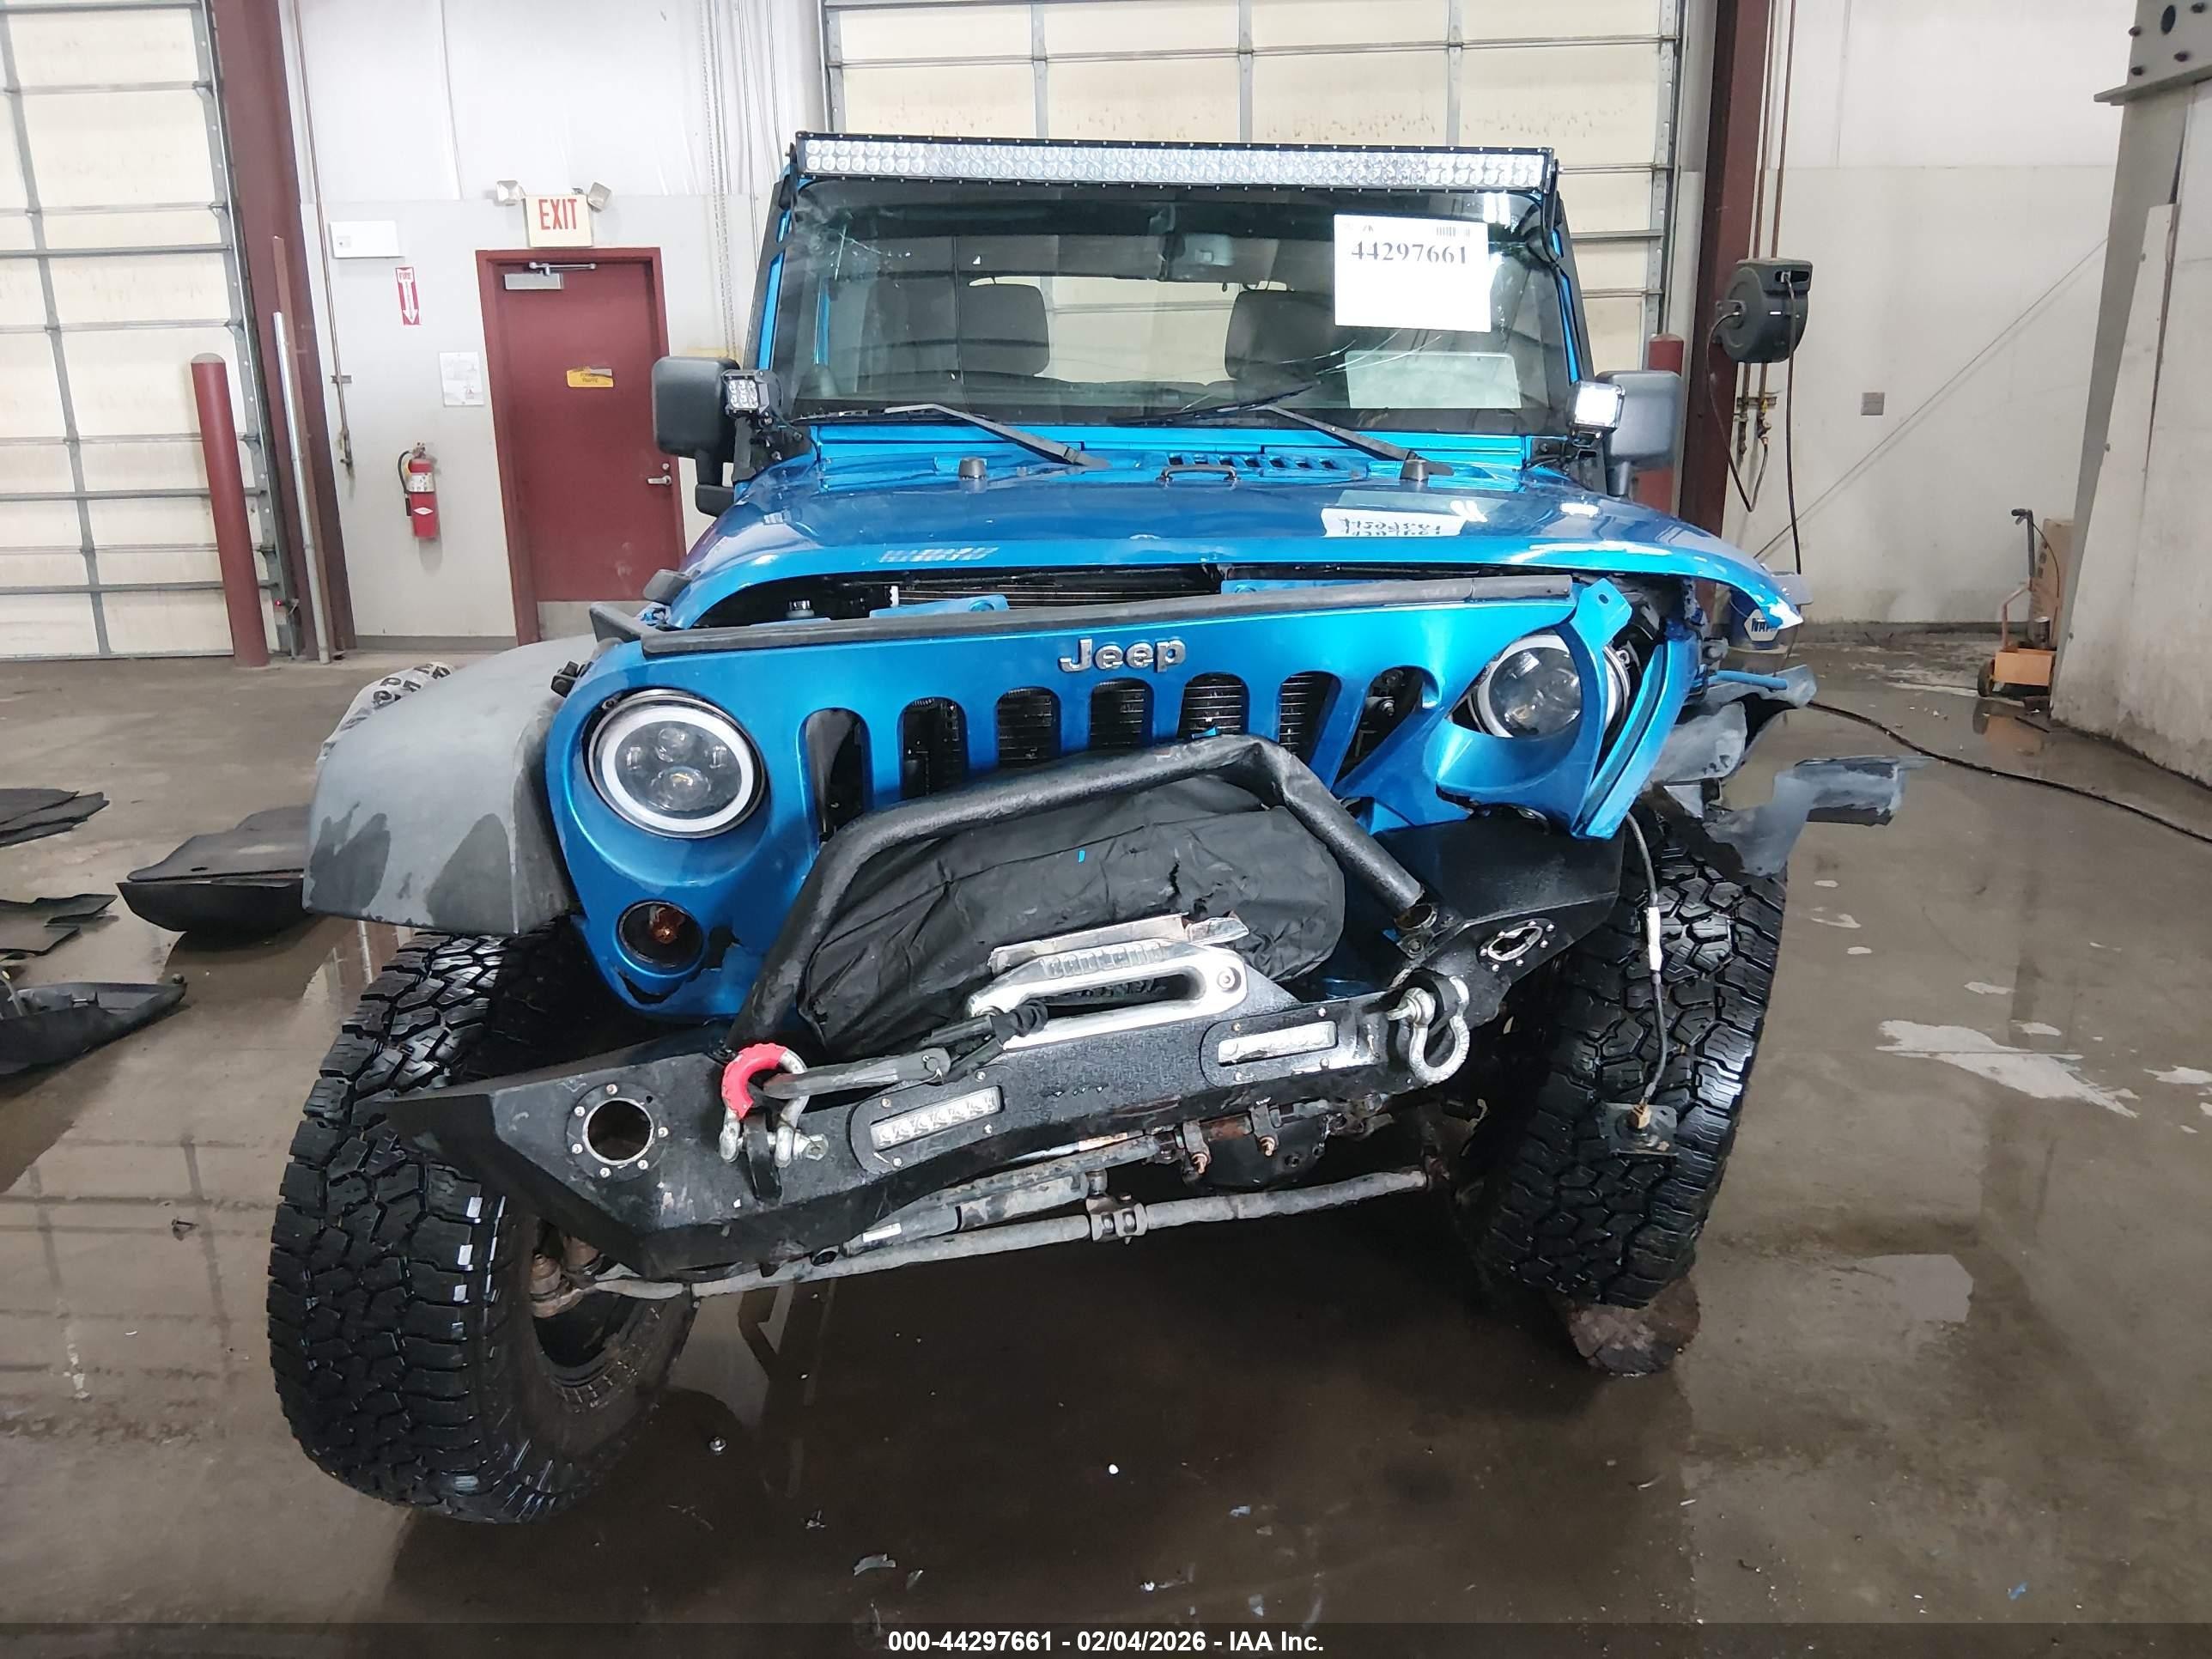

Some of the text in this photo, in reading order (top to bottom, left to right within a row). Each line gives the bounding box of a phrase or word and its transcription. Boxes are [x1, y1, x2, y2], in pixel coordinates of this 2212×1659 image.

[538, 198, 578, 230] EXIT
[1351, 241, 1468, 264] 44297661
[1058, 636, 1187, 673] Jeep
